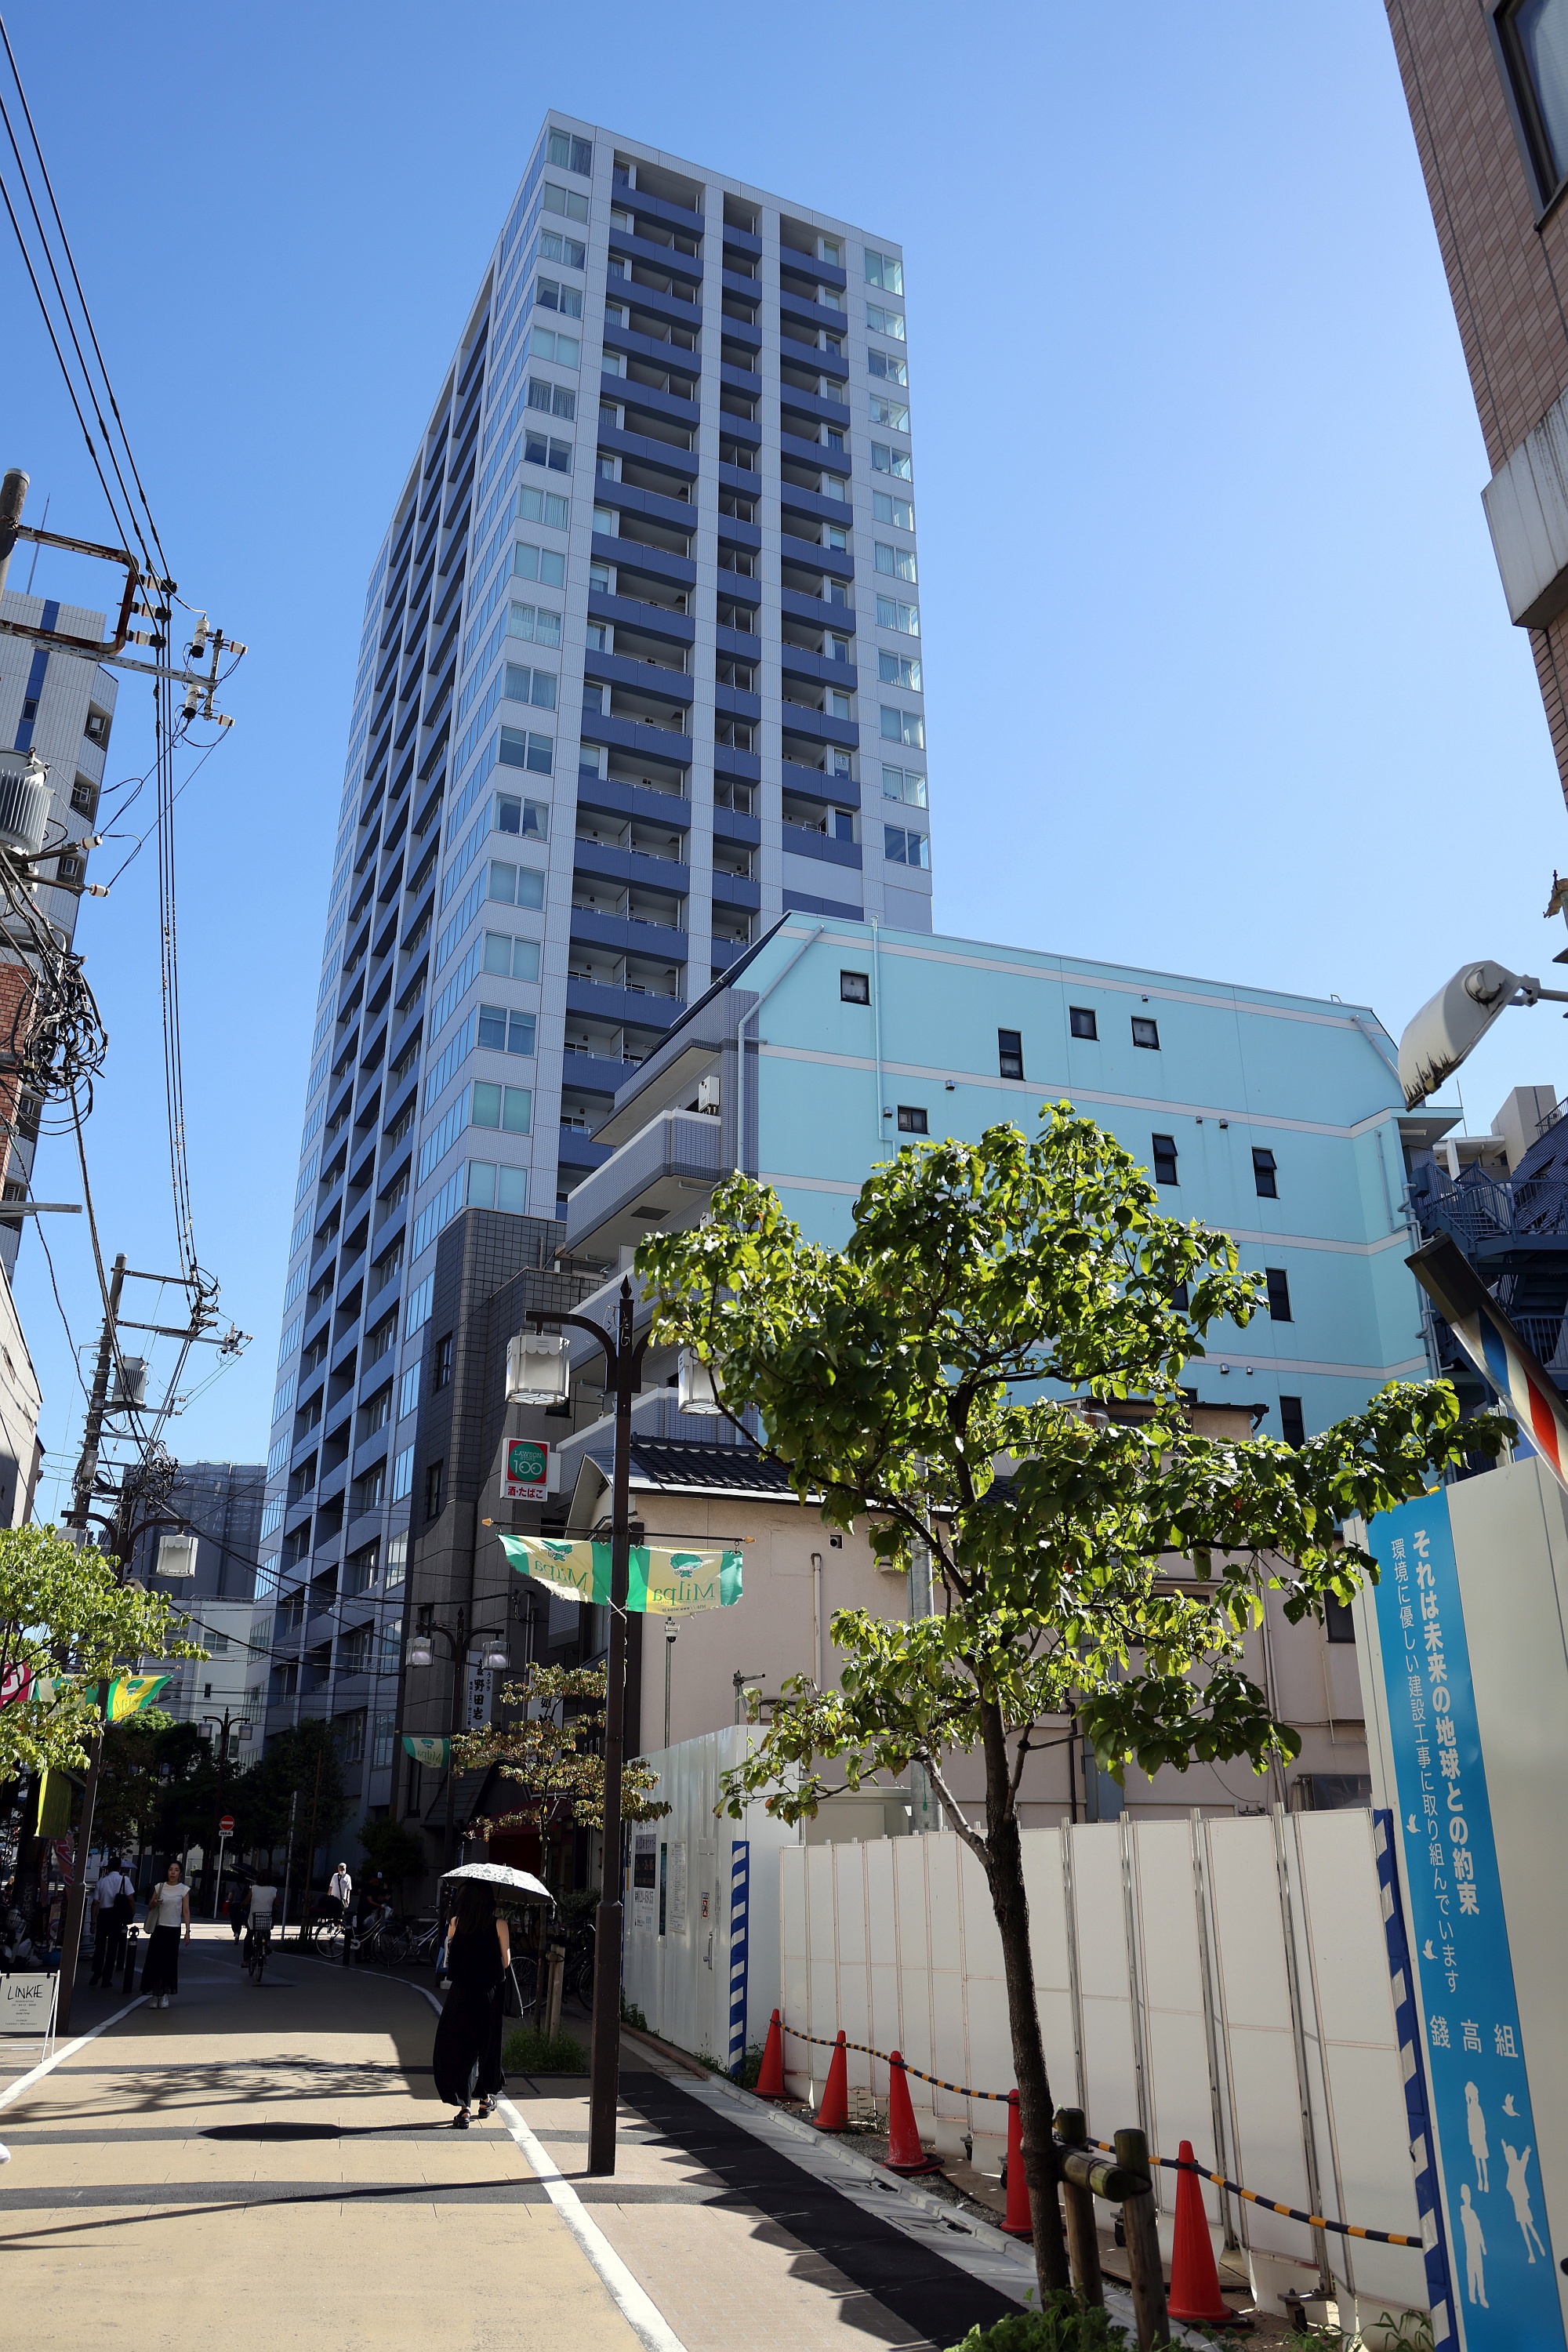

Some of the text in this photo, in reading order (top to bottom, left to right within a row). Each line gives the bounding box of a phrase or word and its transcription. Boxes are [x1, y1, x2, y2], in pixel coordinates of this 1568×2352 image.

[514, 1460, 543, 1475] 100
[473, 1679, 485, 1720] 野田岩
[1412, 1529, 1480, 1916] それは未来の地球との約束
[1391, 1537, 1459, 1994] 環境に優しい建設工事に取り組んでいます
[1429, 2015, 1519, 2059] 錢高組
